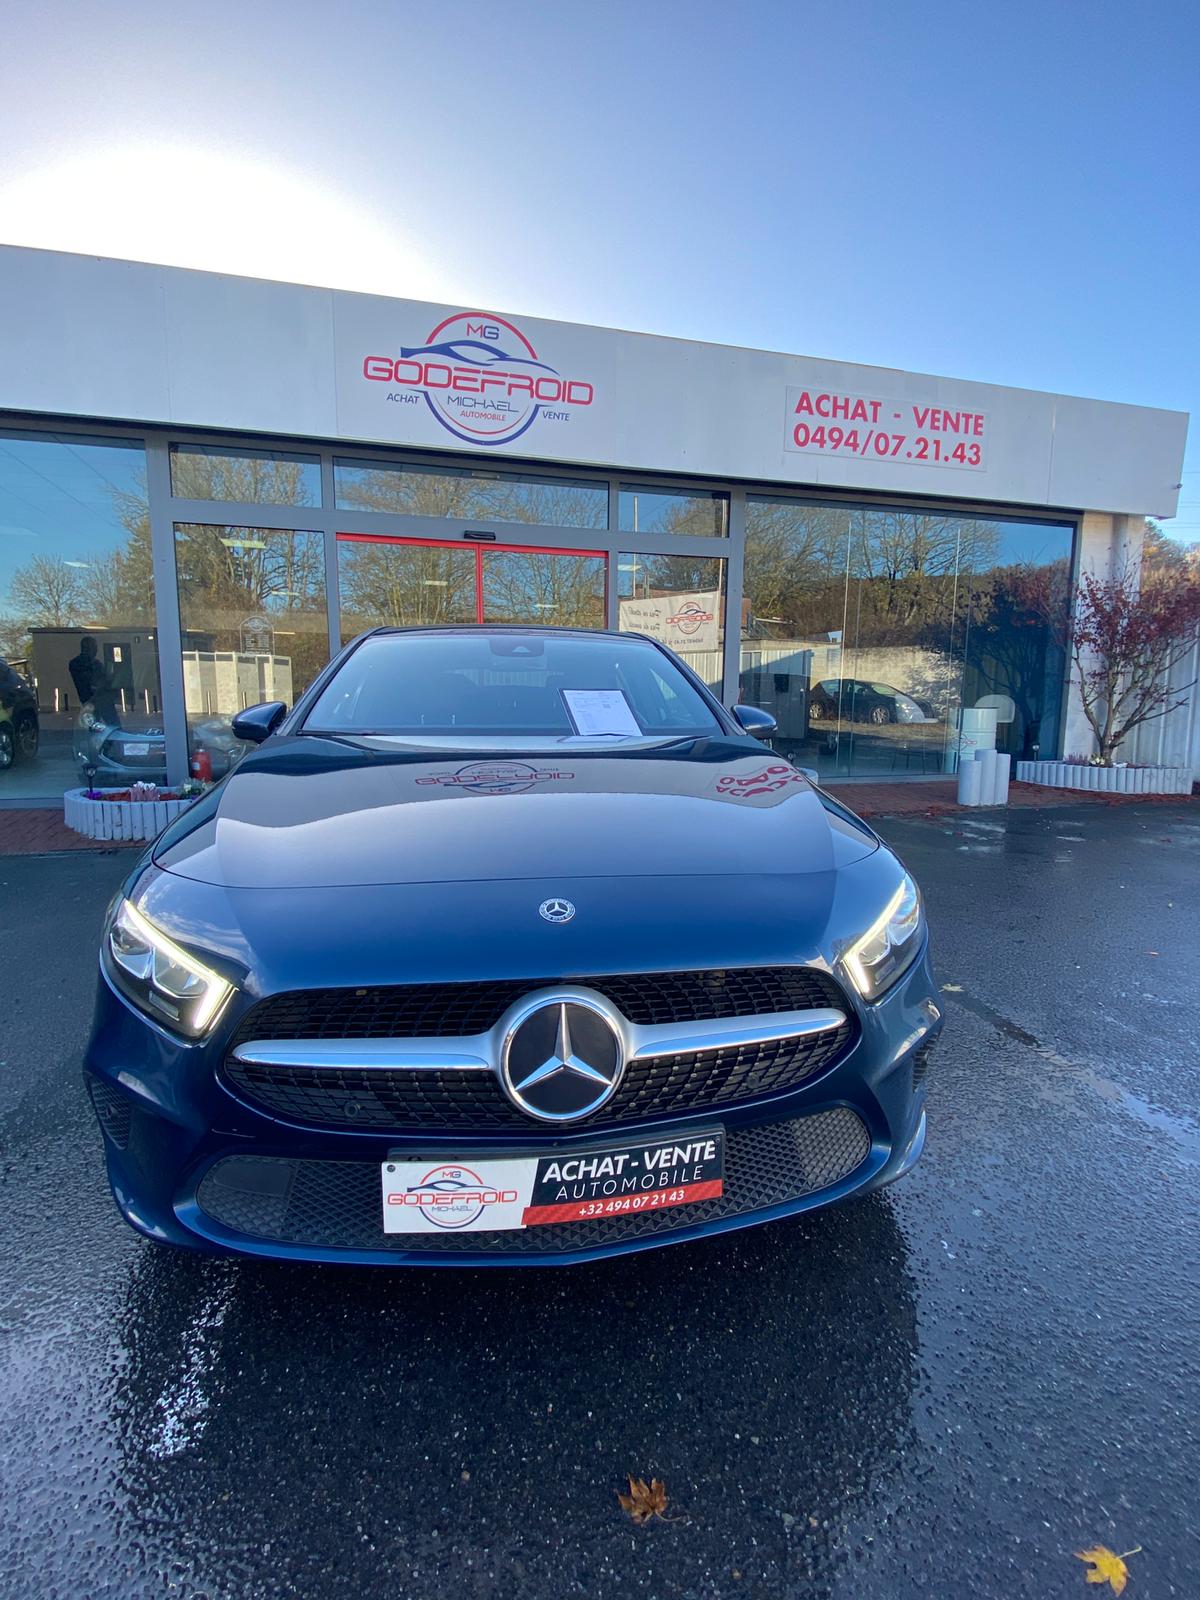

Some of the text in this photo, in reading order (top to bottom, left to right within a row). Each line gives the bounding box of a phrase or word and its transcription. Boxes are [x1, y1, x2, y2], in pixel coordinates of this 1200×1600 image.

[466, 322, 500, 340] MG
[363, 355, 594, 406] GODEFROID
[386, 392, 420, 405] ACHAT
[447, 394, 520, 413] MICHAEL
[460, 410, 507, 422] AUTOMOBILE
[541, 411, 571, 422] VENTE
[795, 391, 882, 424] ACHAT
[912, 406, 984, 436] VENTE
[793, 422, 982, 466] 0494/07.21.43
[542, 1154, 630, 1184] ACHAT
[644, 1140, 716, 1171] VENTE
[442, 1170, 462, 1179] MG
[555, 1165, 704, 1201] AUTOMOBILE
[387, 1190, 518, 1206] GODEFROID
[579, 1190, 685, 1216] +32 494 07 21 43
